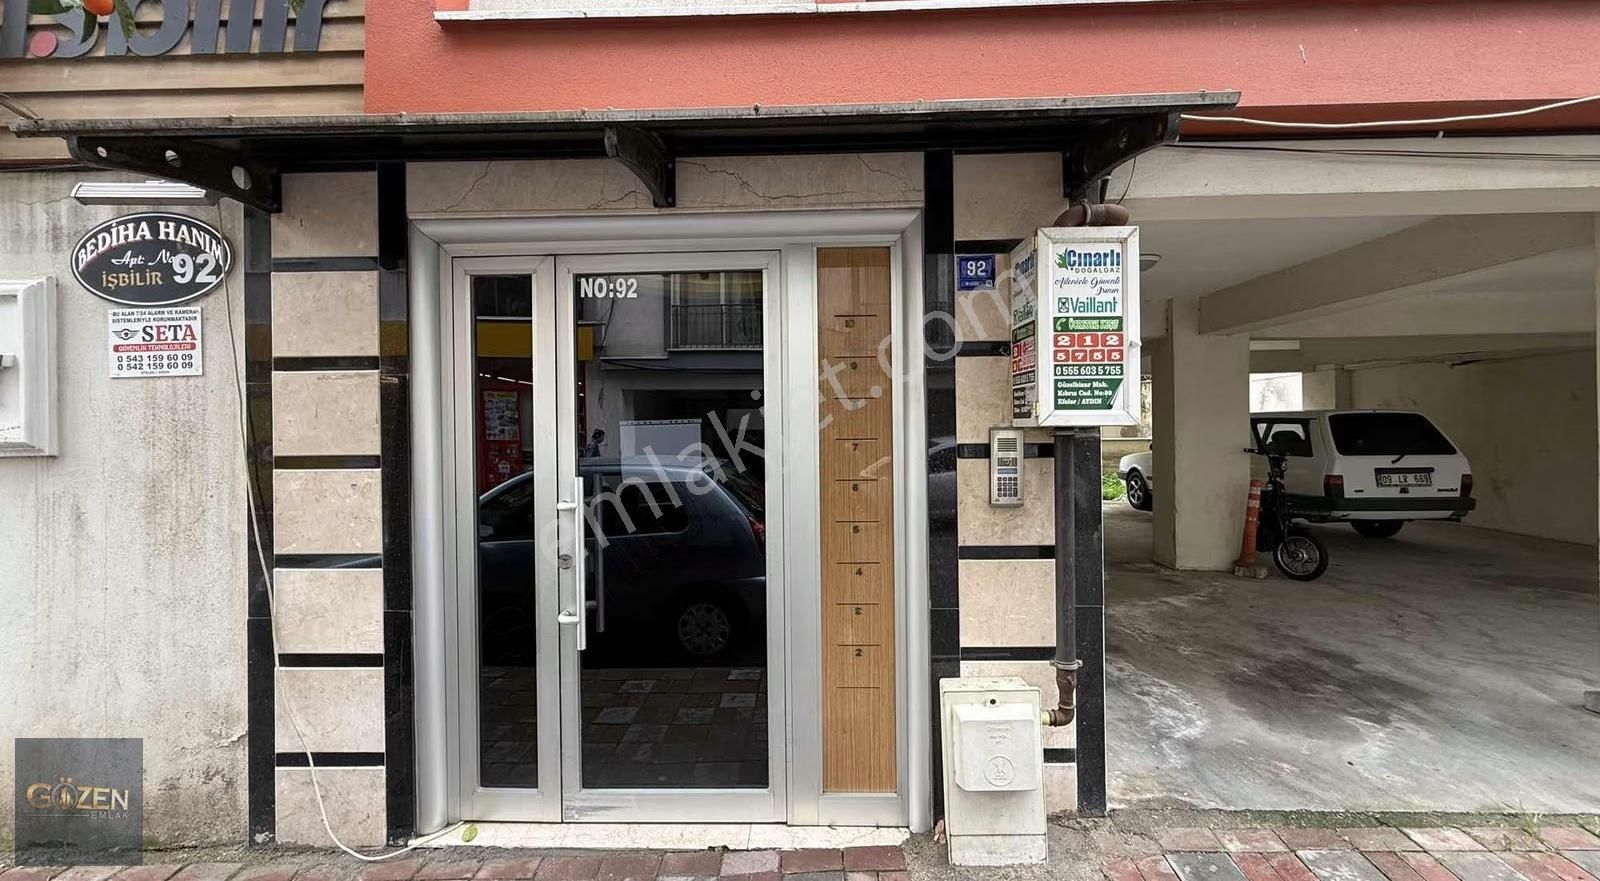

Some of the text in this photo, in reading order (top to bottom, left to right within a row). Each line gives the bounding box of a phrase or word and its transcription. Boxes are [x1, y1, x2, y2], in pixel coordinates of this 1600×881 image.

[78, 221, 225, 272] BEDİHA HANIM
[172, 254, 217, 284] 92
[967, 260, 986, 276] 92
[102, 269, 163, 290] İŞBİLİR
[580, 278, 638, 298] NO:92
[1070, 296, 1118, 313] Vaillant
[142, 324, 197, 342] SETA
[126, 354, 143, 362] 543
[147, 354, 164, 362] 159
[167, 353, 178, 361] 60
[181, 353, 193, 361] 09
[117, 363, 123, 371] 0
[147, 362, 164, 370] 159
[181, 361, 193, 369] 09
[851, 361, 857, 370] 9
[852, 443, 859, 451] 7
[1382, 475, 1392, 484] 09
[852, 484, 859, 492] 6
[852, 525, 860, 534] 5
[855, 567, 863, 576] 4
[855, 649, 862, 657] 2
